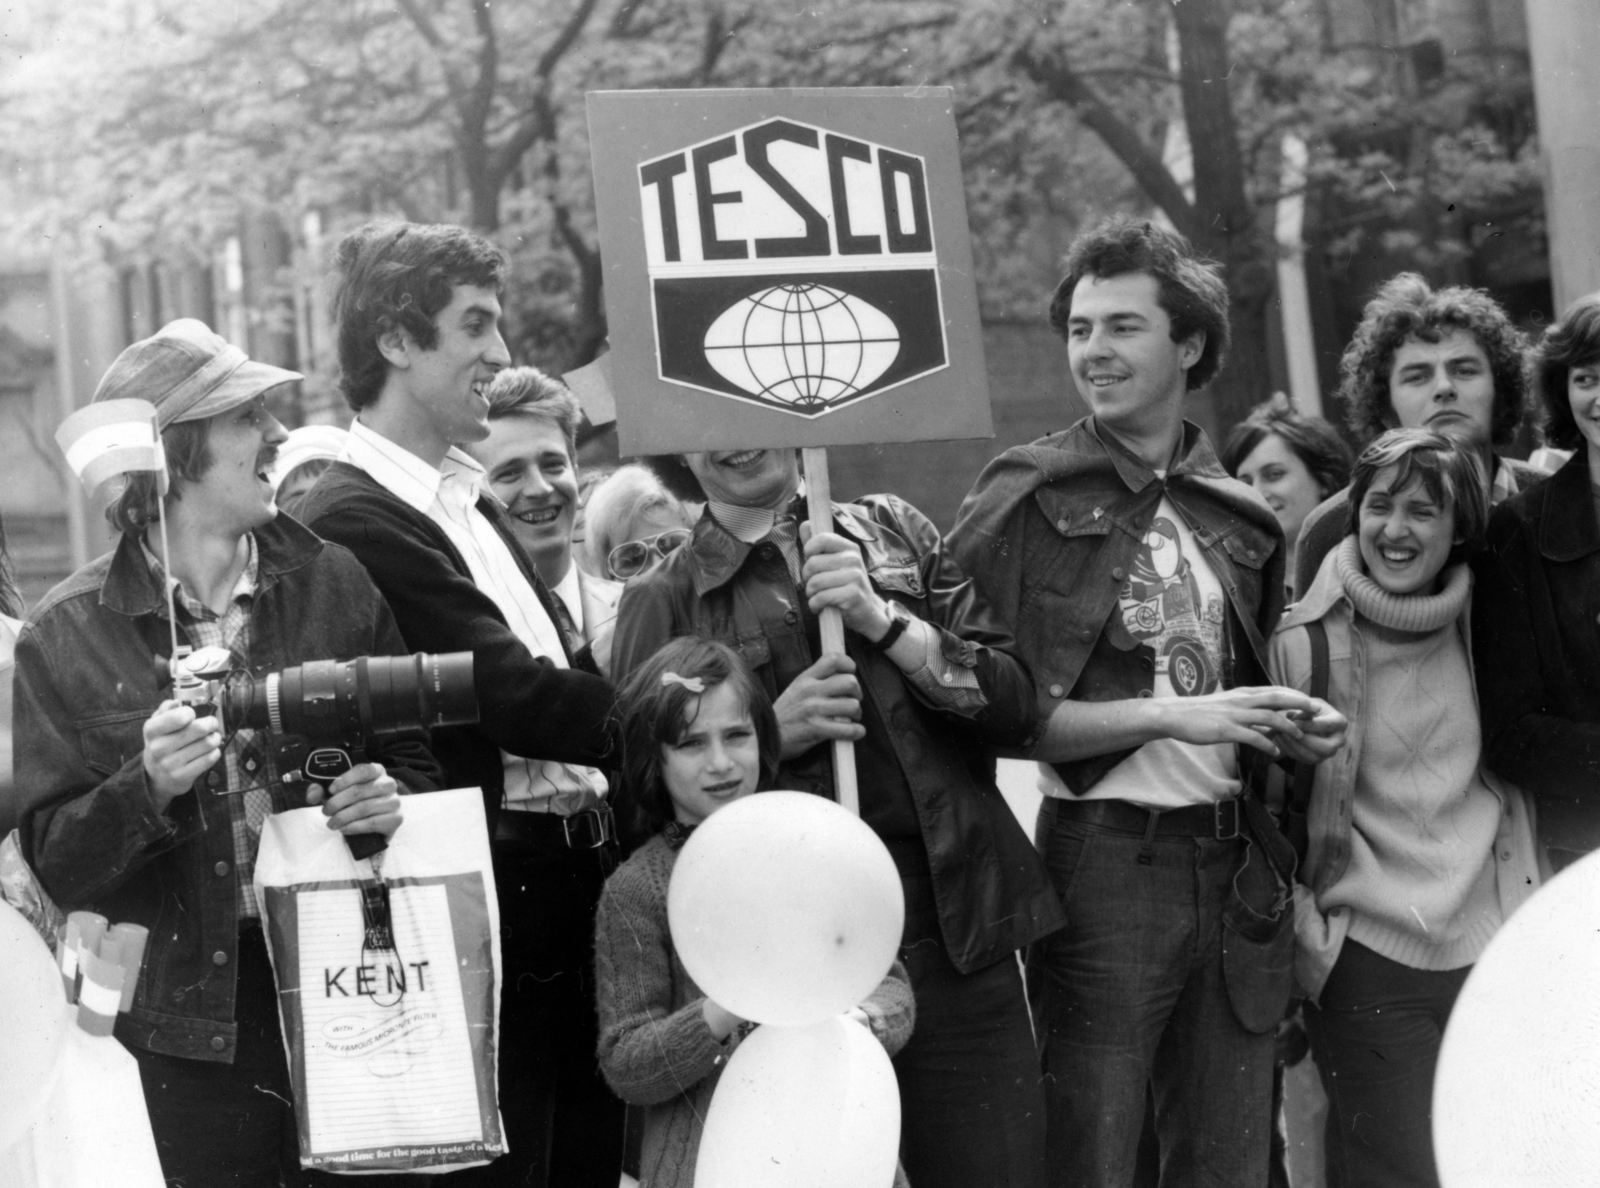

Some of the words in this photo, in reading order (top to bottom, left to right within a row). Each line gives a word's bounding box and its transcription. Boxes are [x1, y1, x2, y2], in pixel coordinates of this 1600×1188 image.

[640, 119, 933, 262] TESCO
[324, 961, 429, 998] KENT
[325, 1041, 338, 1052] THE
[340, 1037, 373, 1051] FAMOUS
[413, 1012, 437, 1021] FILTER
[332, 1025, 353, 1033] WITH
[350, 1151, 374, 1161] time
[376, 1149, 392, 1158] for
[393, 1147, 410, 1157] the
[410, 1146, 436, 1157] good
[437, 1145, 463, 1154] taste
[465, 1142, 476, 1151] of
